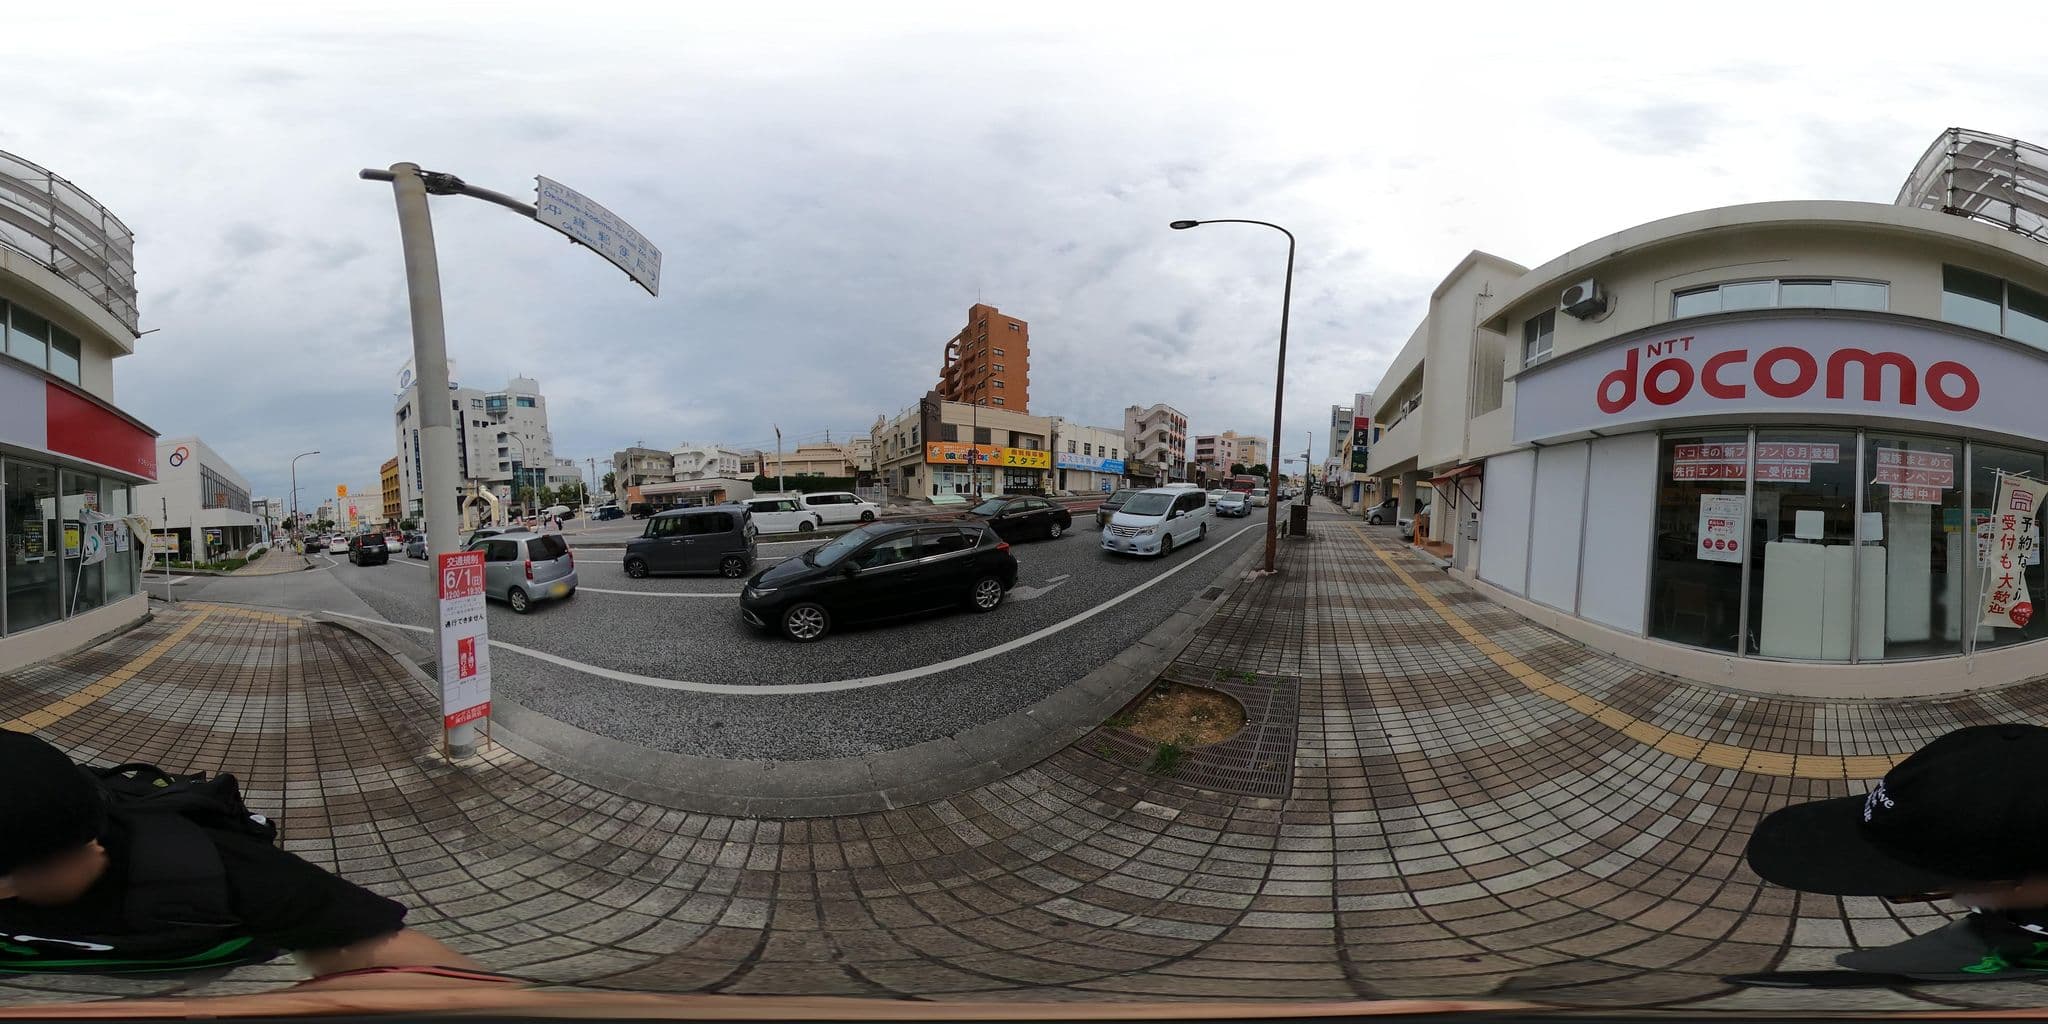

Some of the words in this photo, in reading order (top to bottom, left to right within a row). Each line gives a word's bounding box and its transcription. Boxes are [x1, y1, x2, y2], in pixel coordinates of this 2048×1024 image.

[1647, 336, 1694, 358] NTT
[1597, 346, 1980, 414] docomo
[1007, 456, 1048, 467] スタディ
[1880, 452, 1951, 468] 家族まとめて
[1880, 469, 1951, 484] キャンペーン
[446, 555, 479, 567] 交通規制
[1988, 514, 2016, 615] 受付も大歓迎
[445, 615, 484, 628] 通行できません
